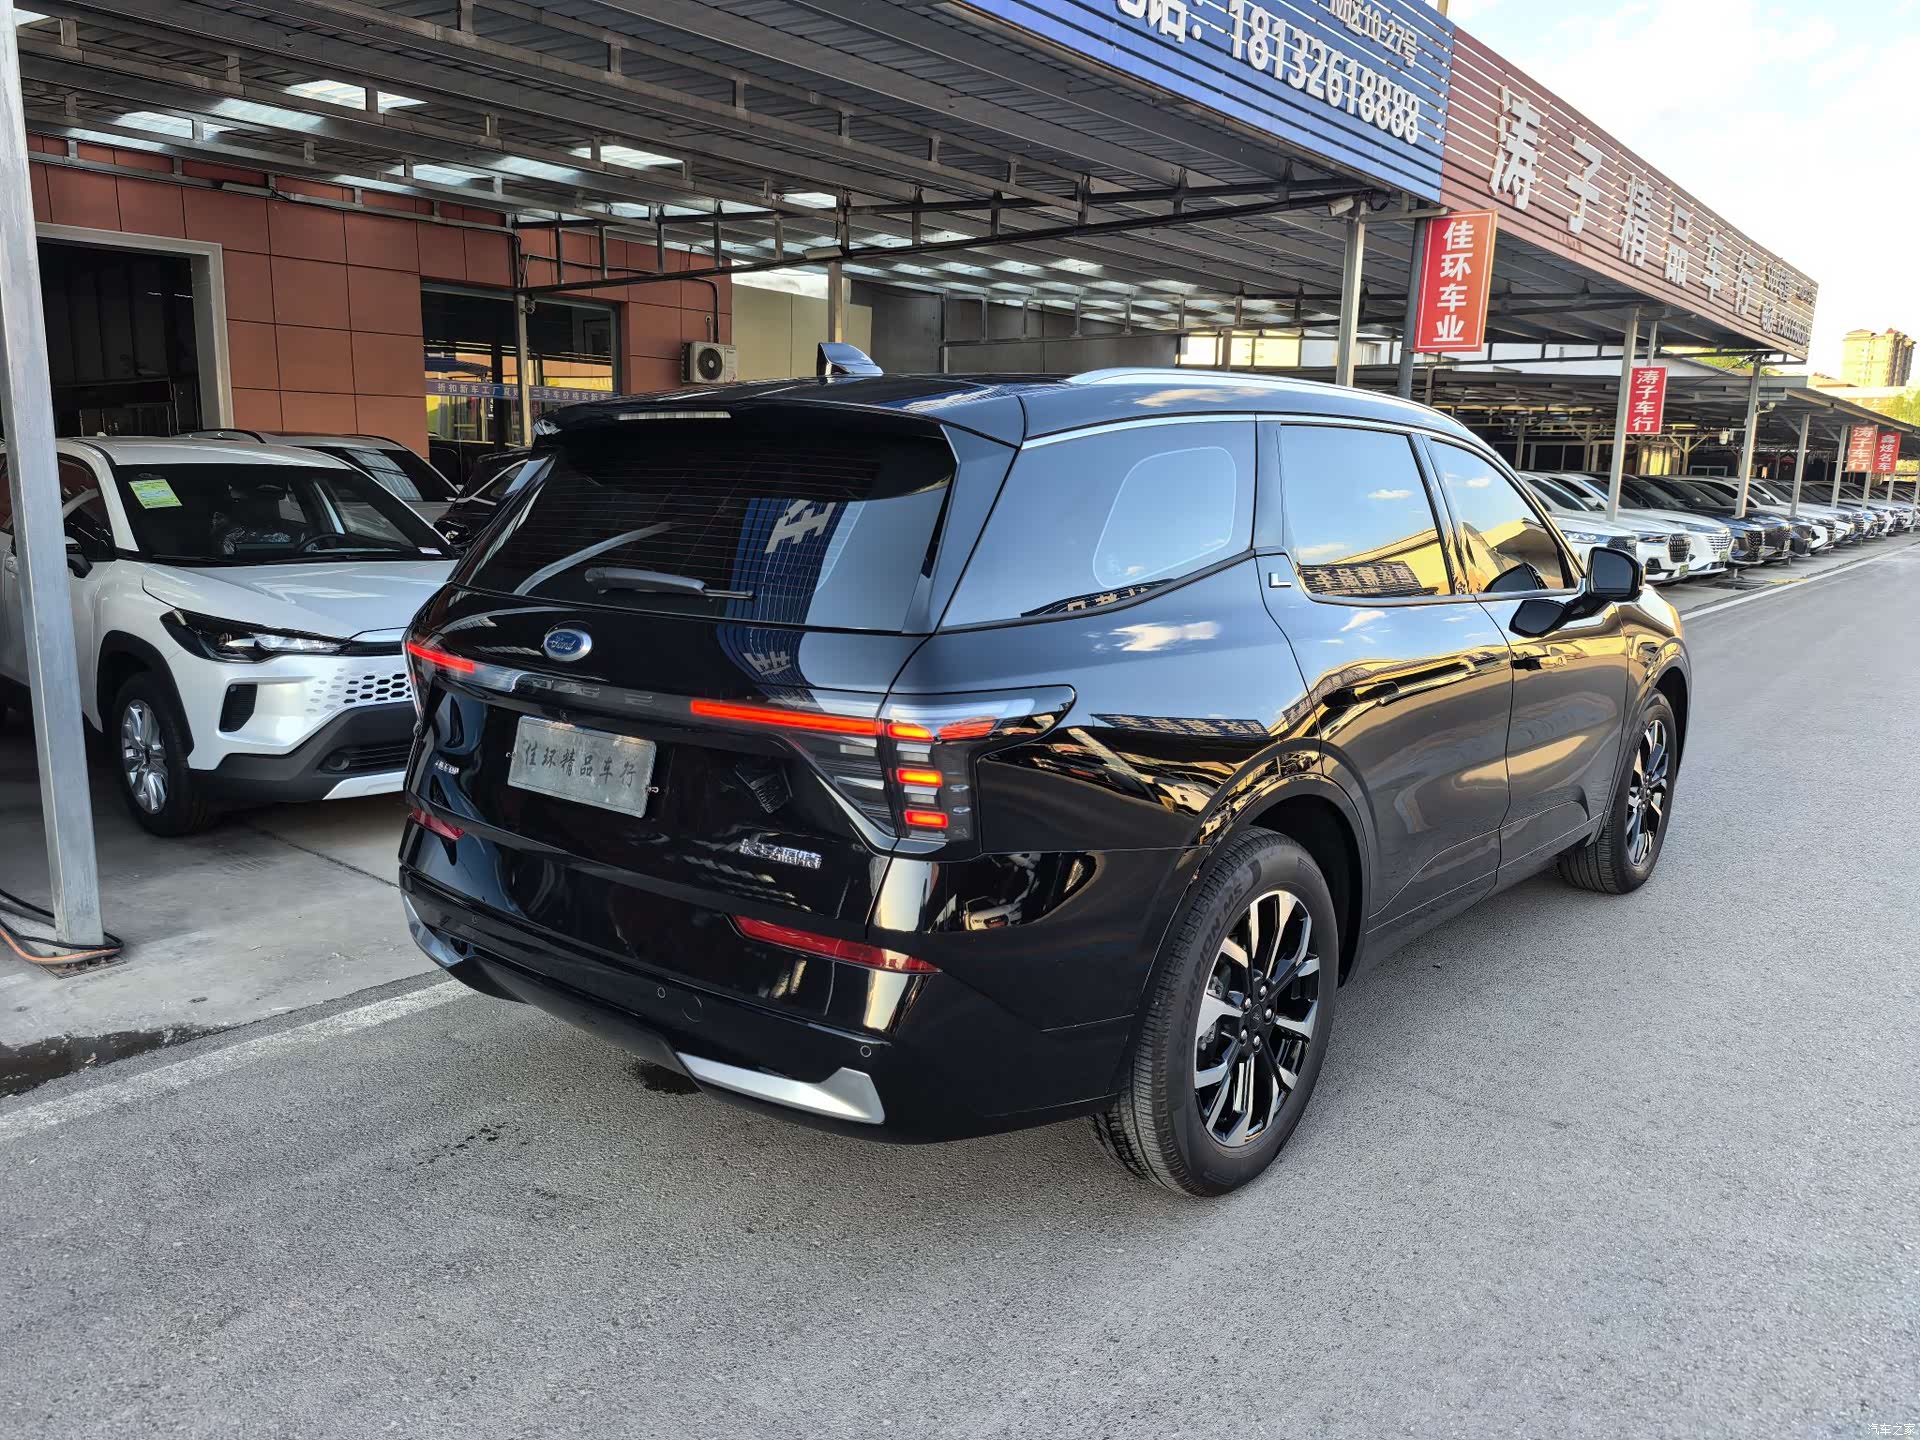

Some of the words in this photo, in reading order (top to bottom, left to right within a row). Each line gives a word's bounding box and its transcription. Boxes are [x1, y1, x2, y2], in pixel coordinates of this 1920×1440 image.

[1228, 0, 1421, 145] 18132618888
[1489, 85, 1757, 315] 涛子精品车行
[1432, 220, 1475, 342] 佳环车业
[1631, 369, 1660, 432] 涛子车行
